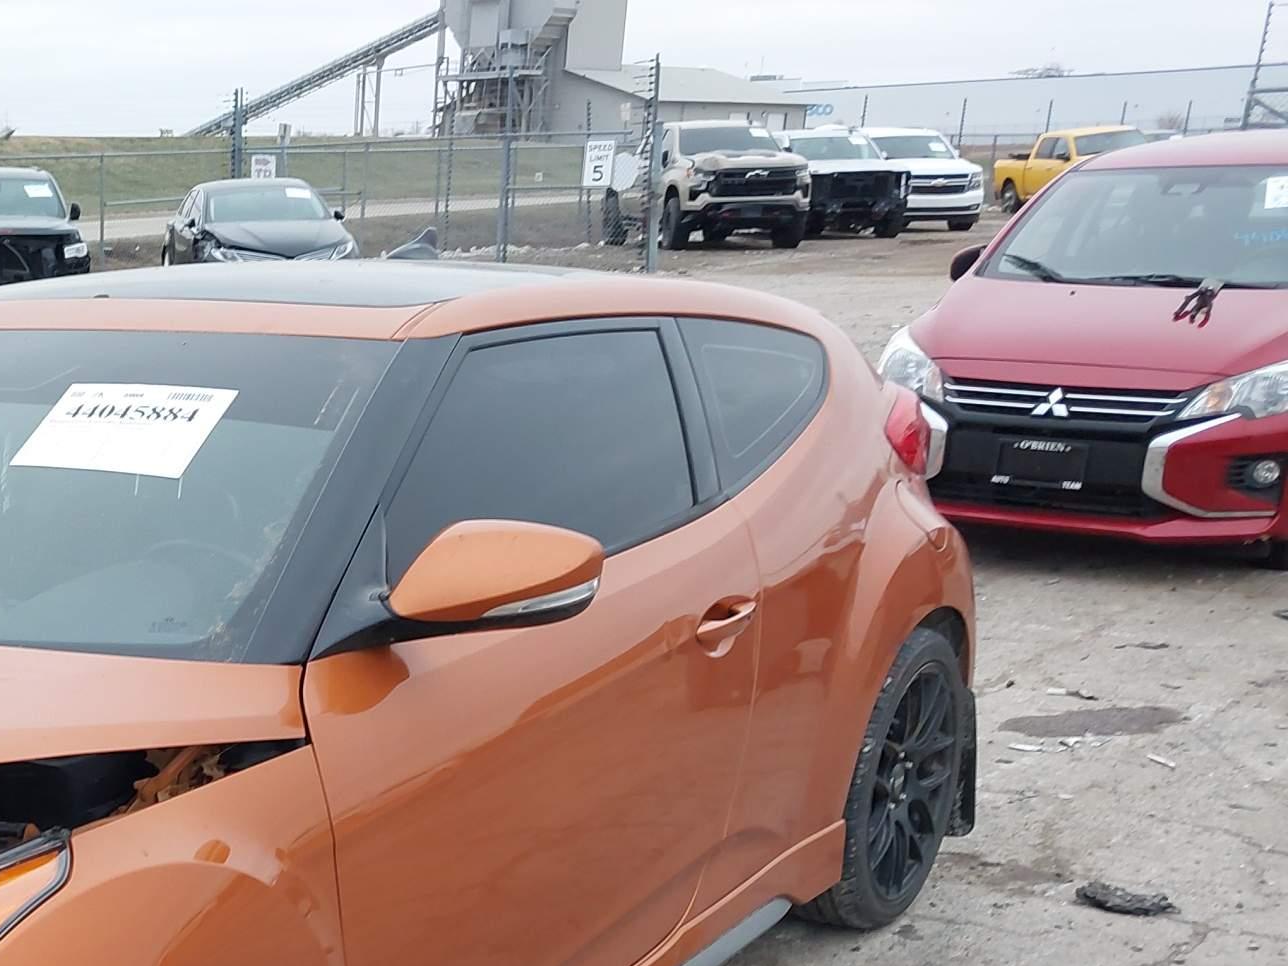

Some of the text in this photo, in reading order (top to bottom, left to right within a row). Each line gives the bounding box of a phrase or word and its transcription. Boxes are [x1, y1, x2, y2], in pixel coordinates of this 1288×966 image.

[588, 144, 613, 152] SPEED
[589, 154, 609, 162] LIMIT
[591, 164, 604, 182] 5
[65, 404, 200, 422] 44045884
[1019, 440, 1065, 452] O'BRIEN
[1062, 480, 1083, 490] TEAM
